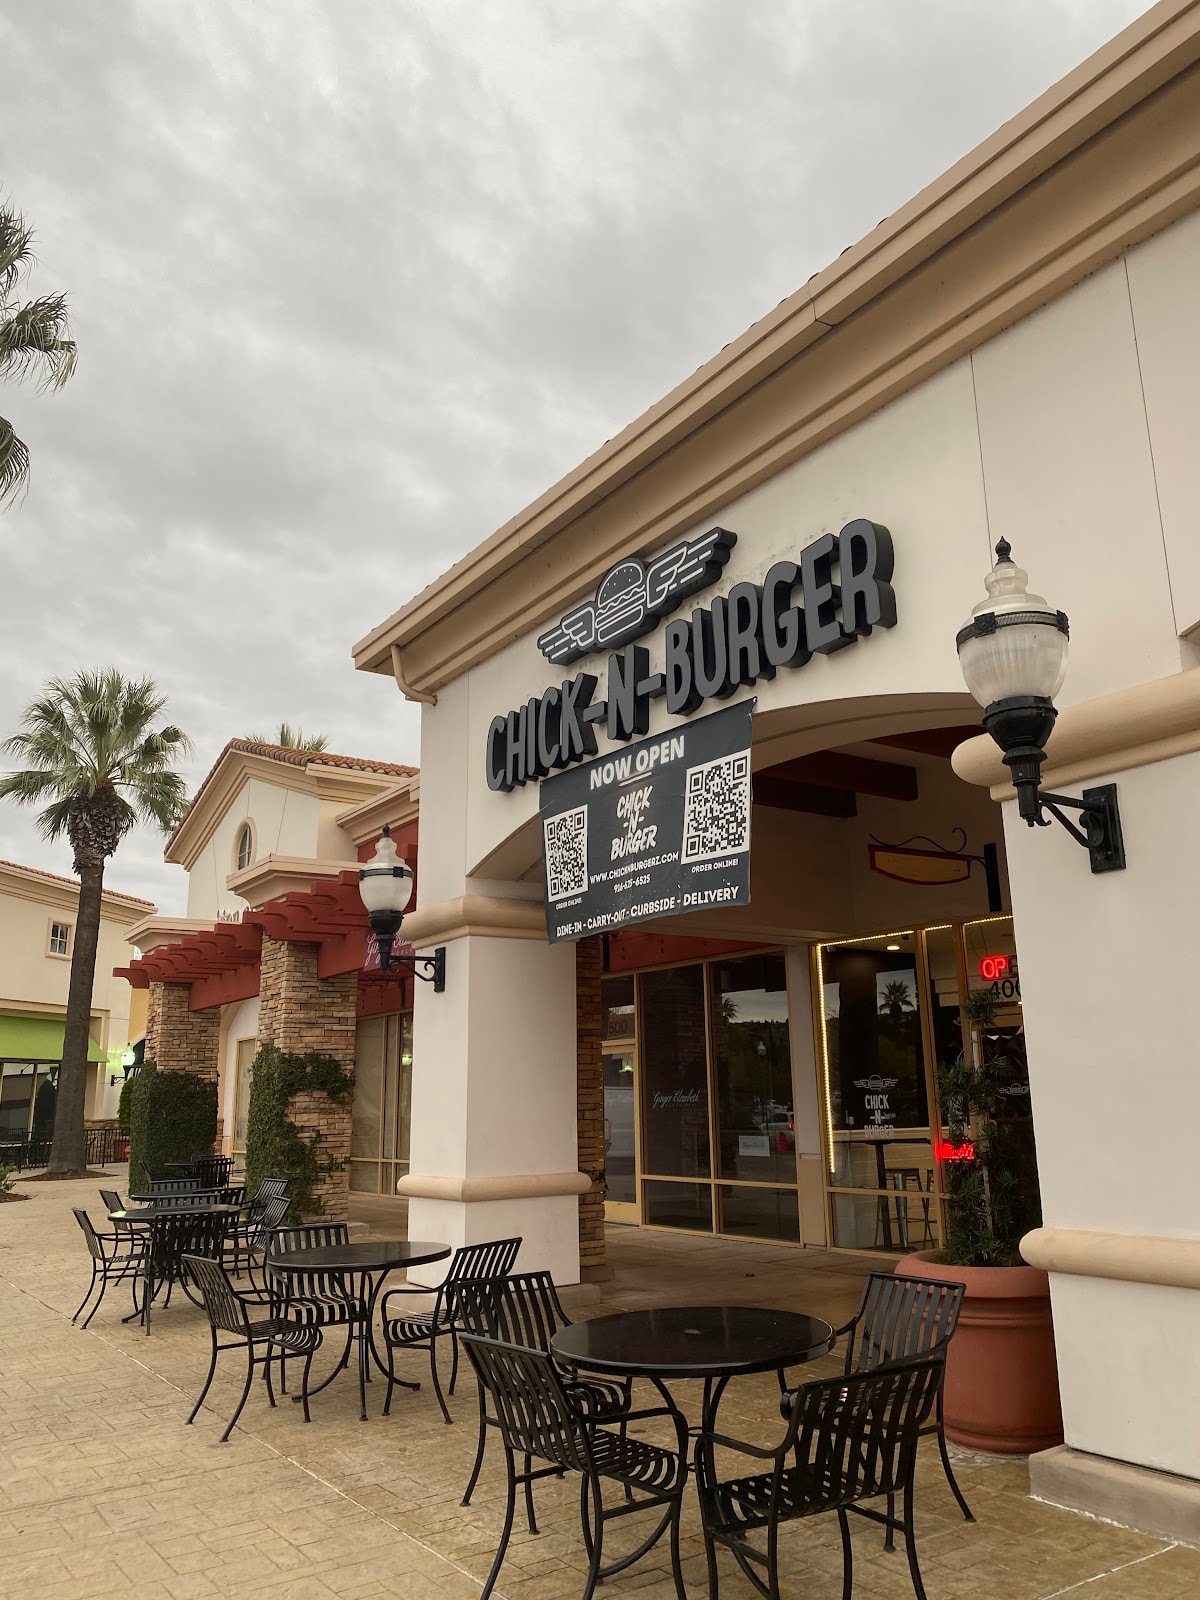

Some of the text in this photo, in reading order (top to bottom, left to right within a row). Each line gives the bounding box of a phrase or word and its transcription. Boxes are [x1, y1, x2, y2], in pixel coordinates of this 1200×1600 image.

[486, 518, 896, 792] CHICK-N-BURGER
[590, 735, 685, 790] NOW OPEN
[616, 786, 653, 818] CHICK
[623, 809, 645, 833] -N-
[610, 825, 658, 861] BURGER
[691, 858, 739, 874] ORDER ONLINE!
[556, 920, 583, 938] DINE-IN
[587, 908, 626, 930] CARRY-OUT
[630, 895, 676, 919] CURBSIDE
[682, 885, 740, 907] DELIVERY
[608, 1020, 628, 1034] 500
[864, 1094, 890, 1110] CHICK
